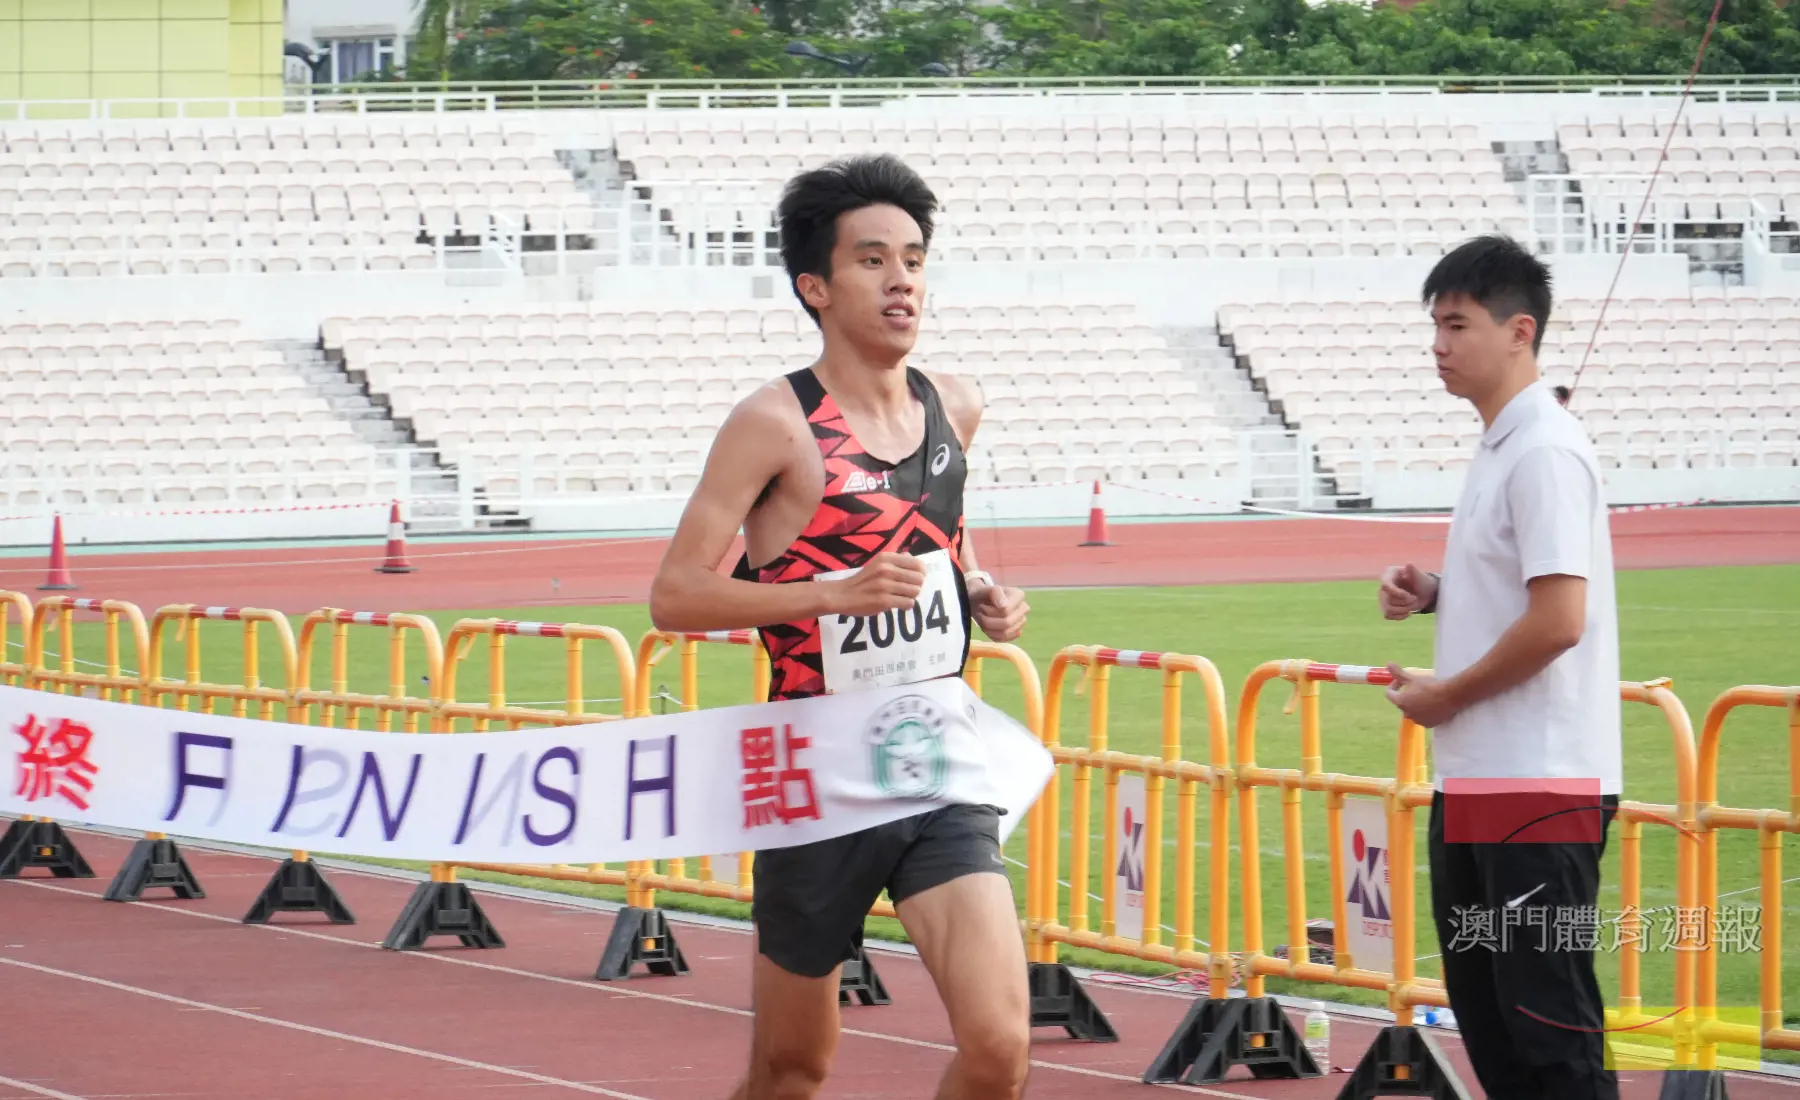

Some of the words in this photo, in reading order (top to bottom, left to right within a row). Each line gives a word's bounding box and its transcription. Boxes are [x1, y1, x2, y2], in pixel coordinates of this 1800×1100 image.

[838, 590, 949, 655] 2004
[14, 713, 100, 811] 終
[163, 732, 678, 847] FINISH
[739, 723, 823, 830] 點
